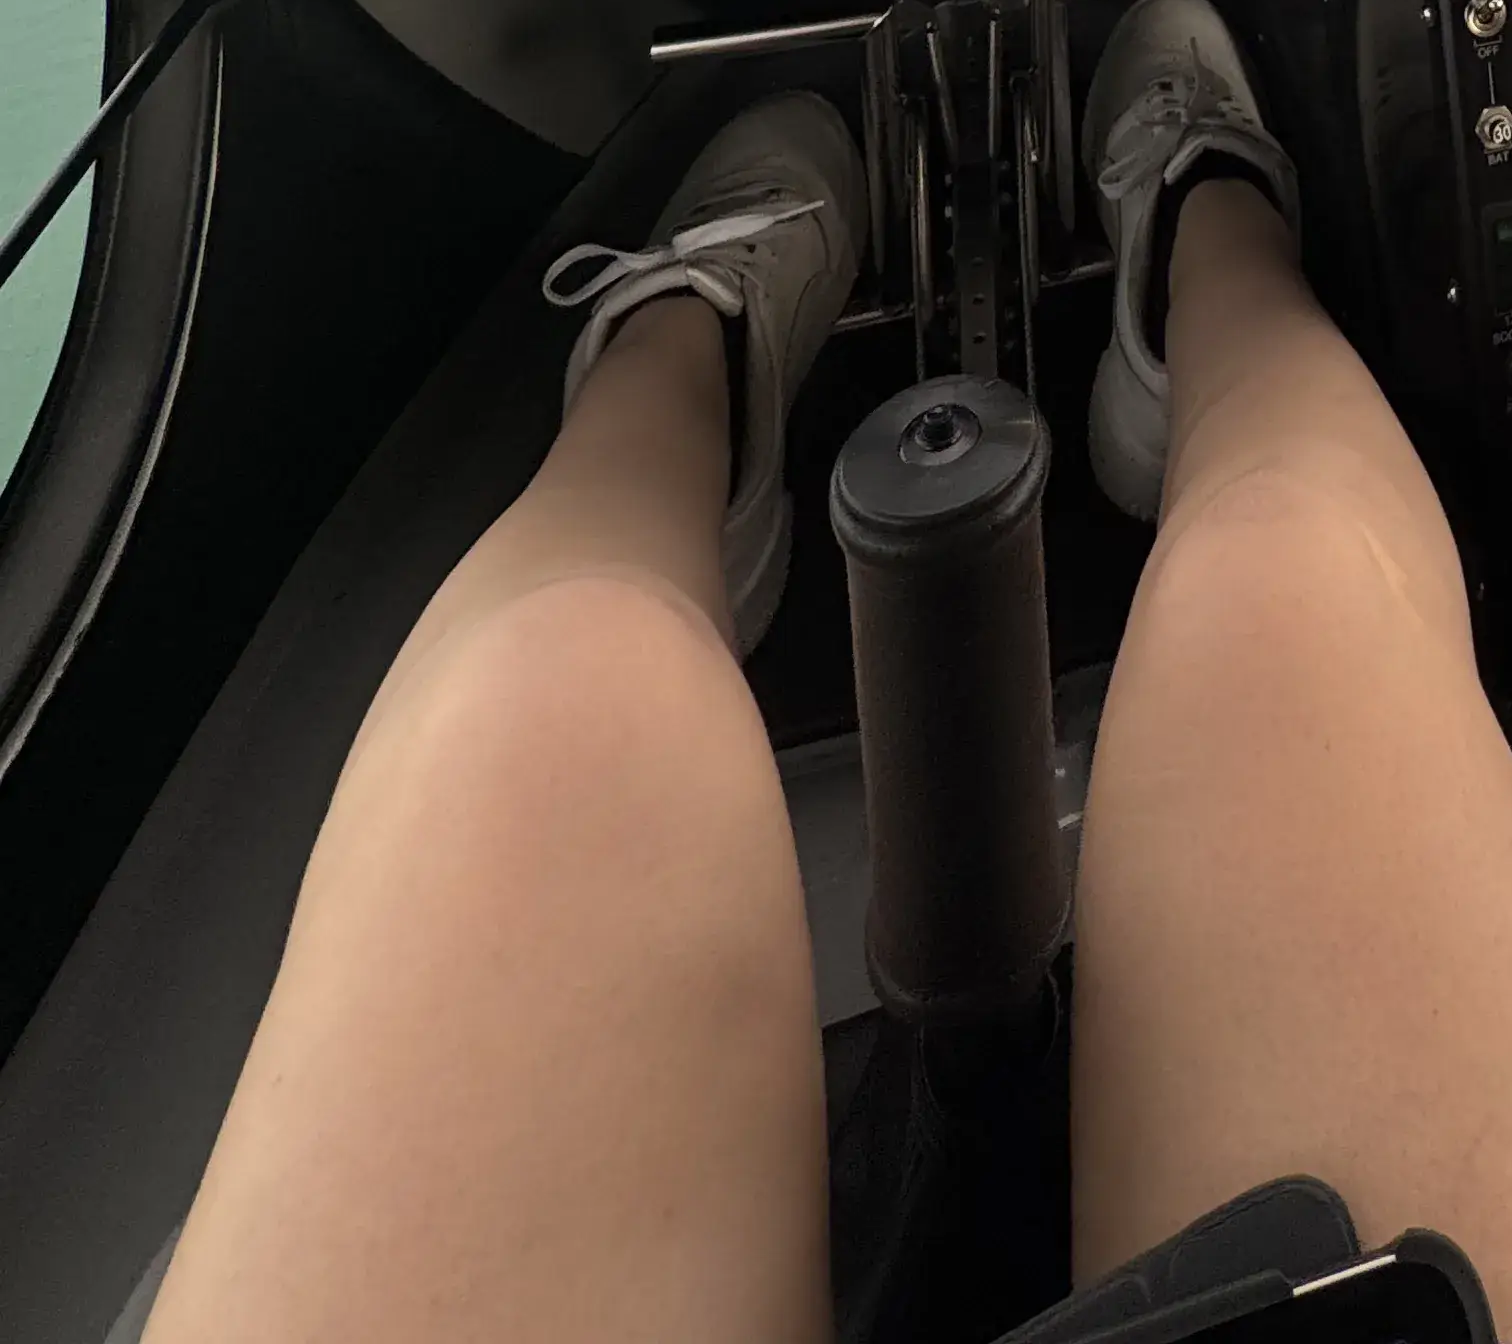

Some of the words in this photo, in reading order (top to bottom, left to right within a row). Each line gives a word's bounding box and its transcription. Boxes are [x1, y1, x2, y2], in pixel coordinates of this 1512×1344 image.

[1478, 46, 1499, 59] OFF
[1492, 124, 1512, 143] 30
[1488, 153, 1510, 166] BAT
